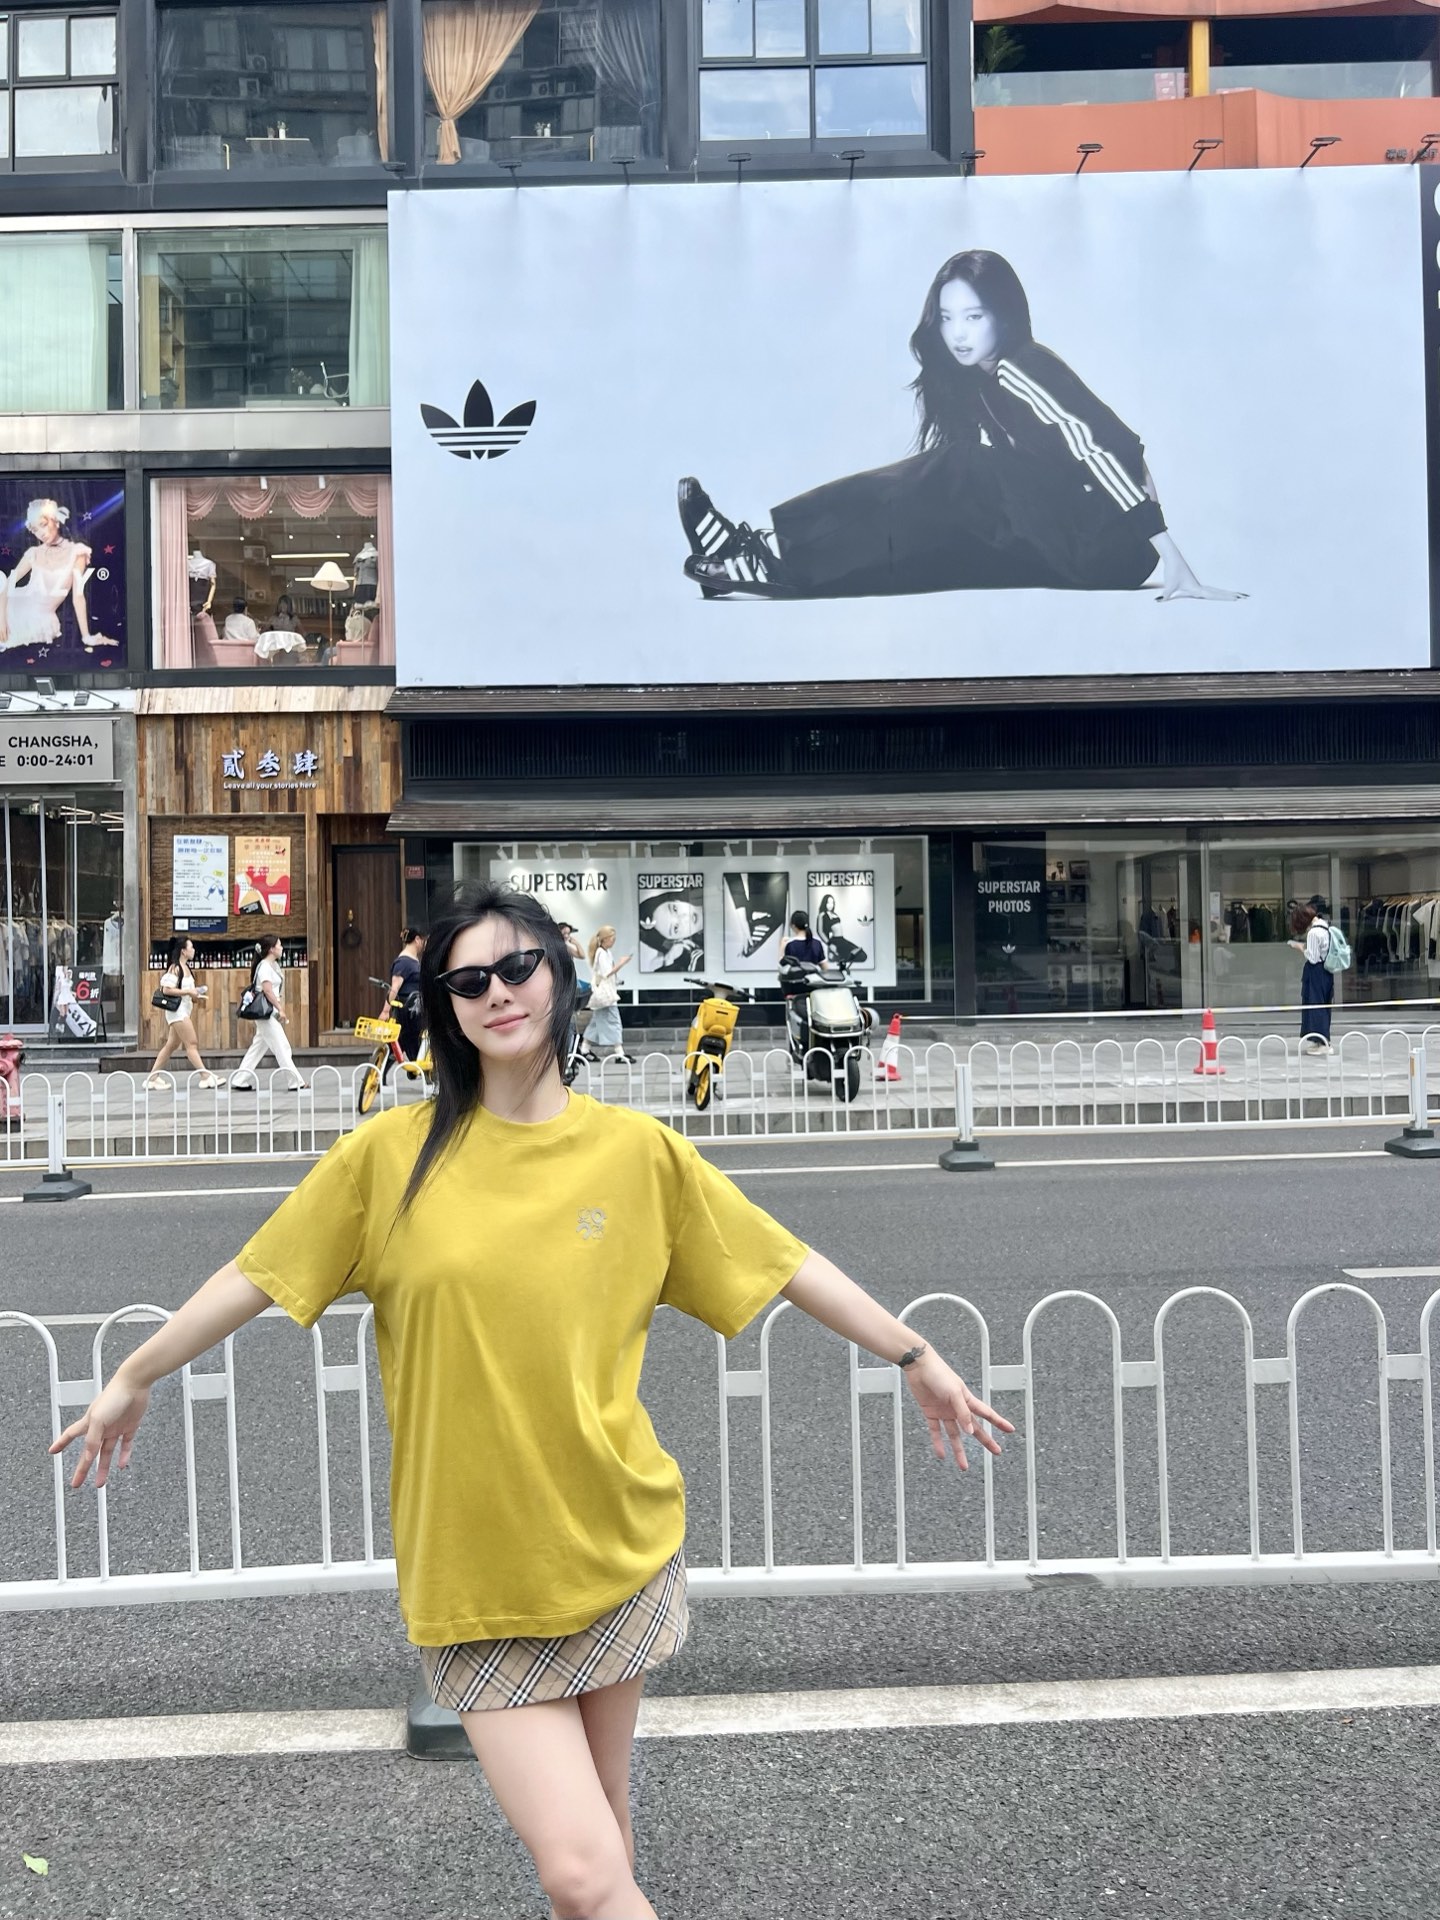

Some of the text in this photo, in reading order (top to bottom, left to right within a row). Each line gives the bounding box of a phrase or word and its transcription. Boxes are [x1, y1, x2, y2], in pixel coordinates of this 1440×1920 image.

[8, 735, 99, 750] CHANGSHA,
[17, 754, 93, 767] 0:00-24:01
[221, 749, 318, 780] 贰叁肆
[256, 783, 272, 791] your
[510, 872, 608, 893] SUPERSTAR
[638, 874, 703, 888] SUPERSTAR
[808, 871, 873, 886] SUPERSTAR
[977, 880, 1040, 894] SUPERSTAR
[988, 900, 1031, 913] PHOTOS
